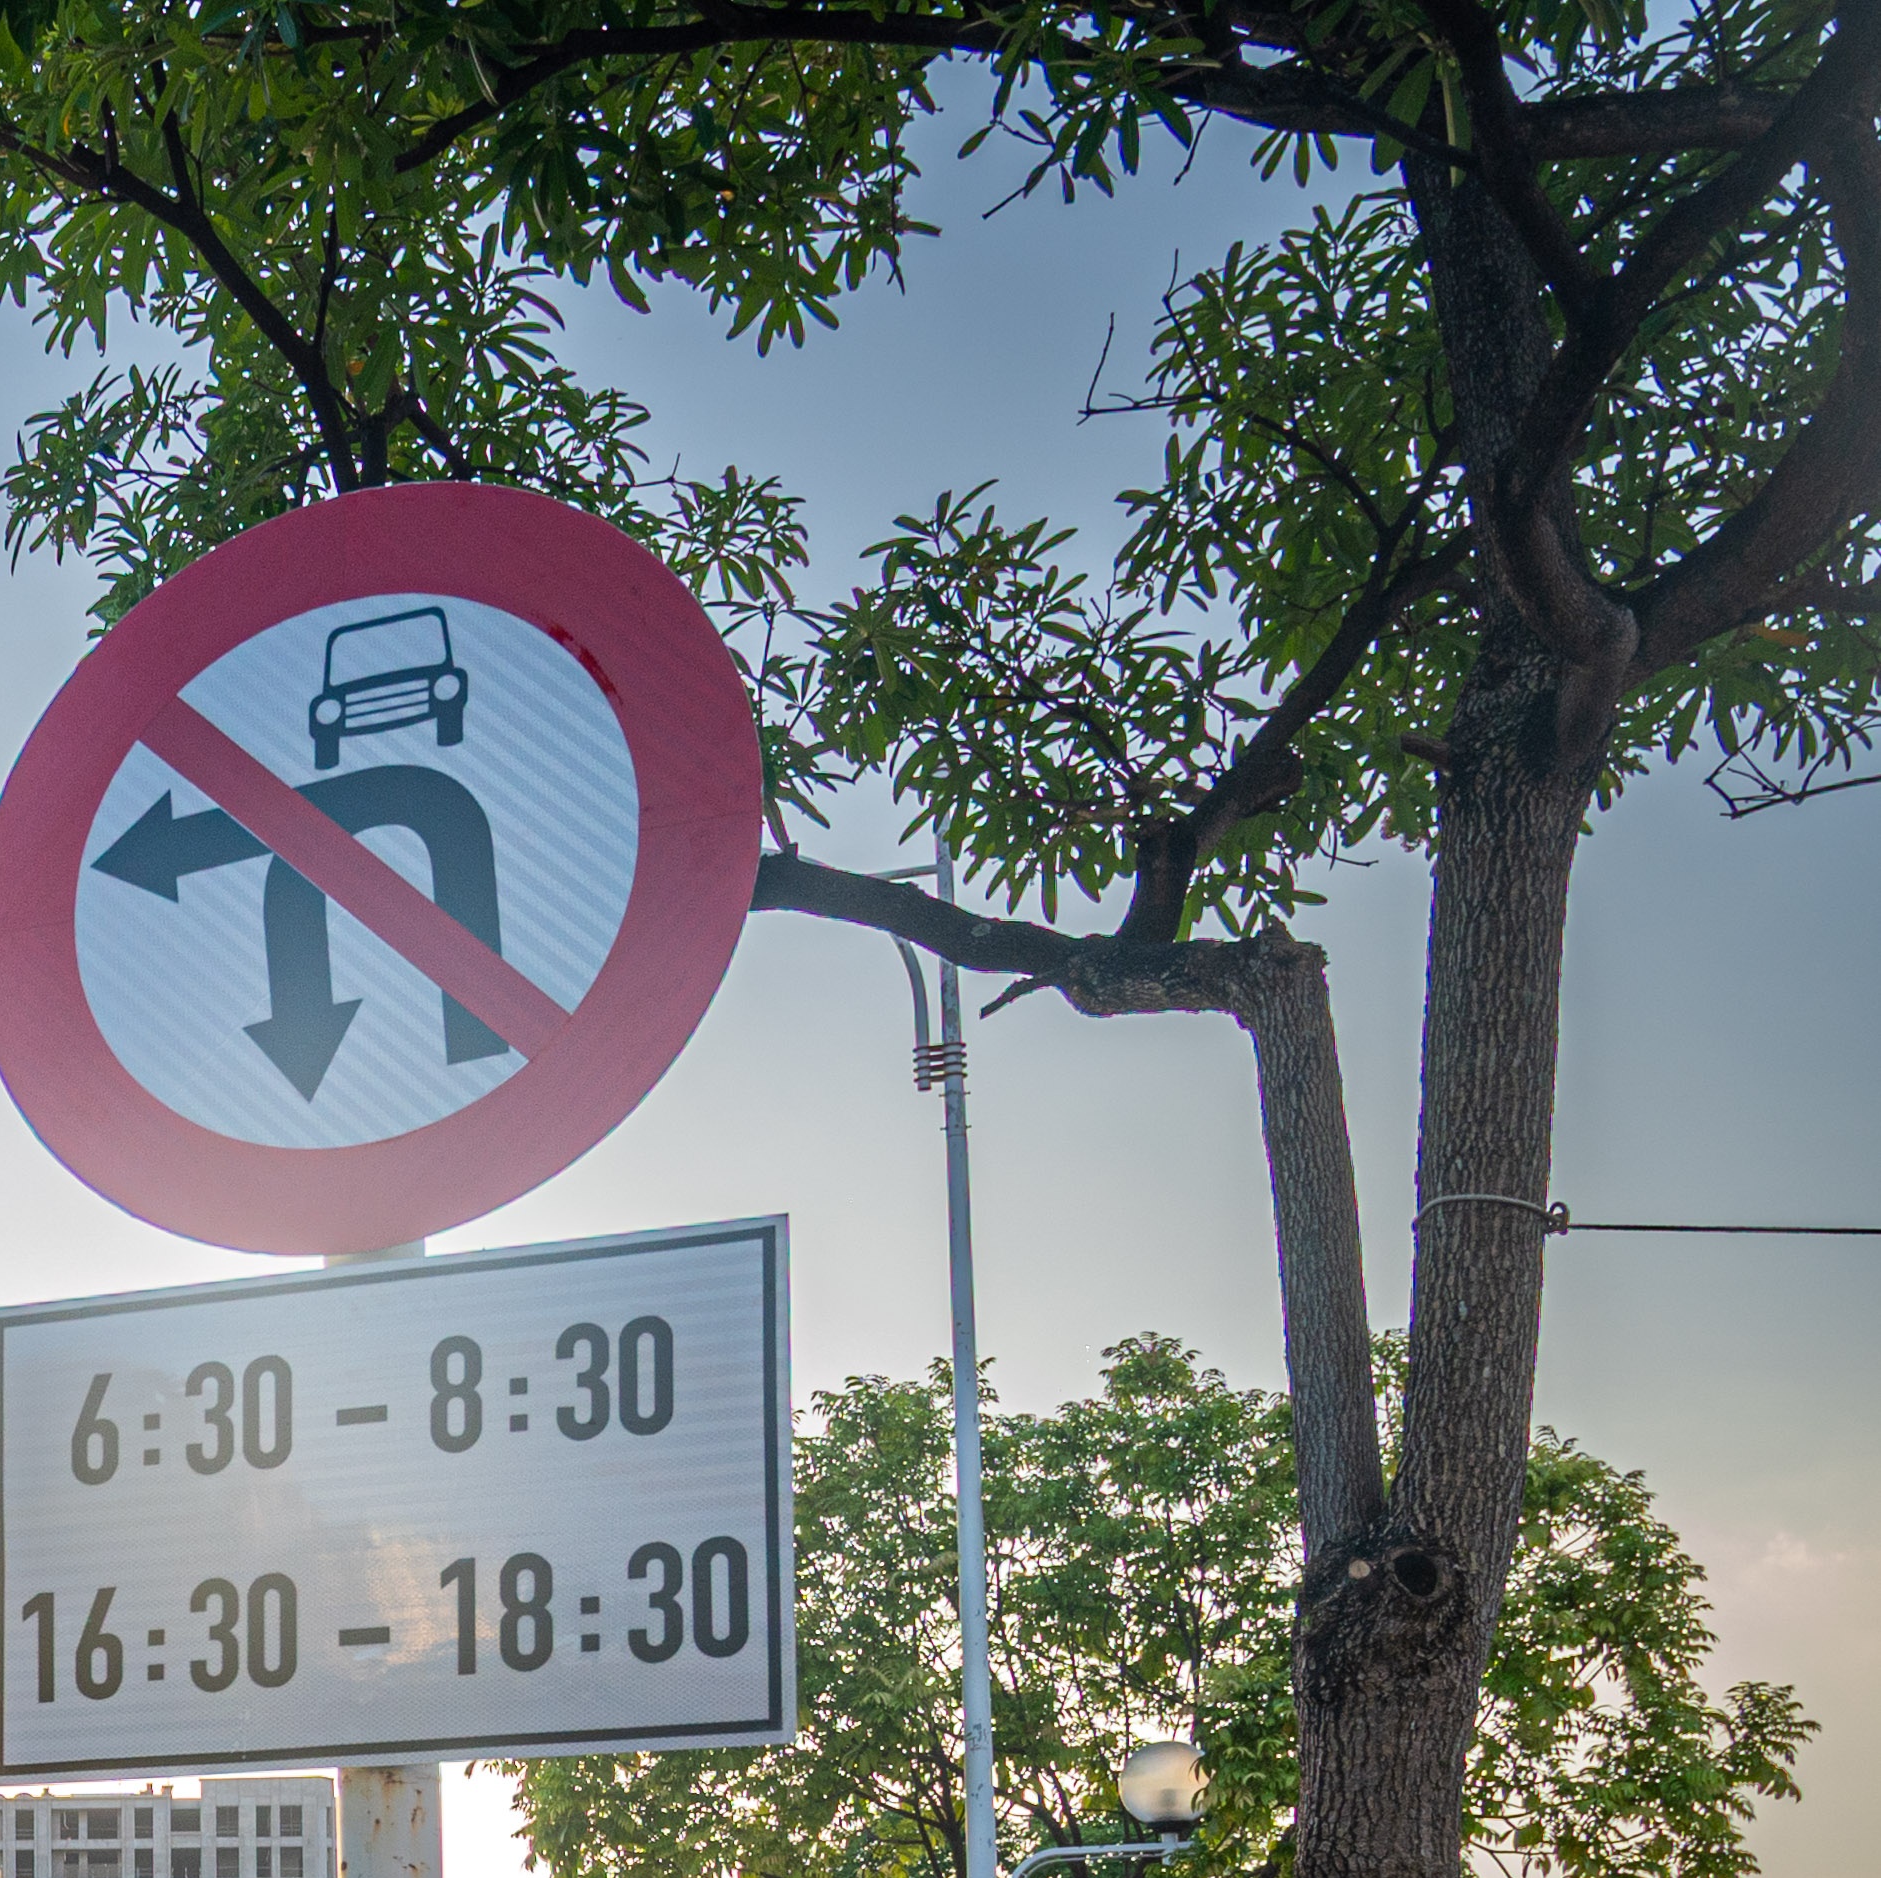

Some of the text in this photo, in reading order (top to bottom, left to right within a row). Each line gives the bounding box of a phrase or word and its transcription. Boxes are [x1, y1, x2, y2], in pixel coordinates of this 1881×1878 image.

[72, 1315, 675, 1486] 6:30 - 8:30
[21, 1536, 749, 1704] 16:30 - 18:30
